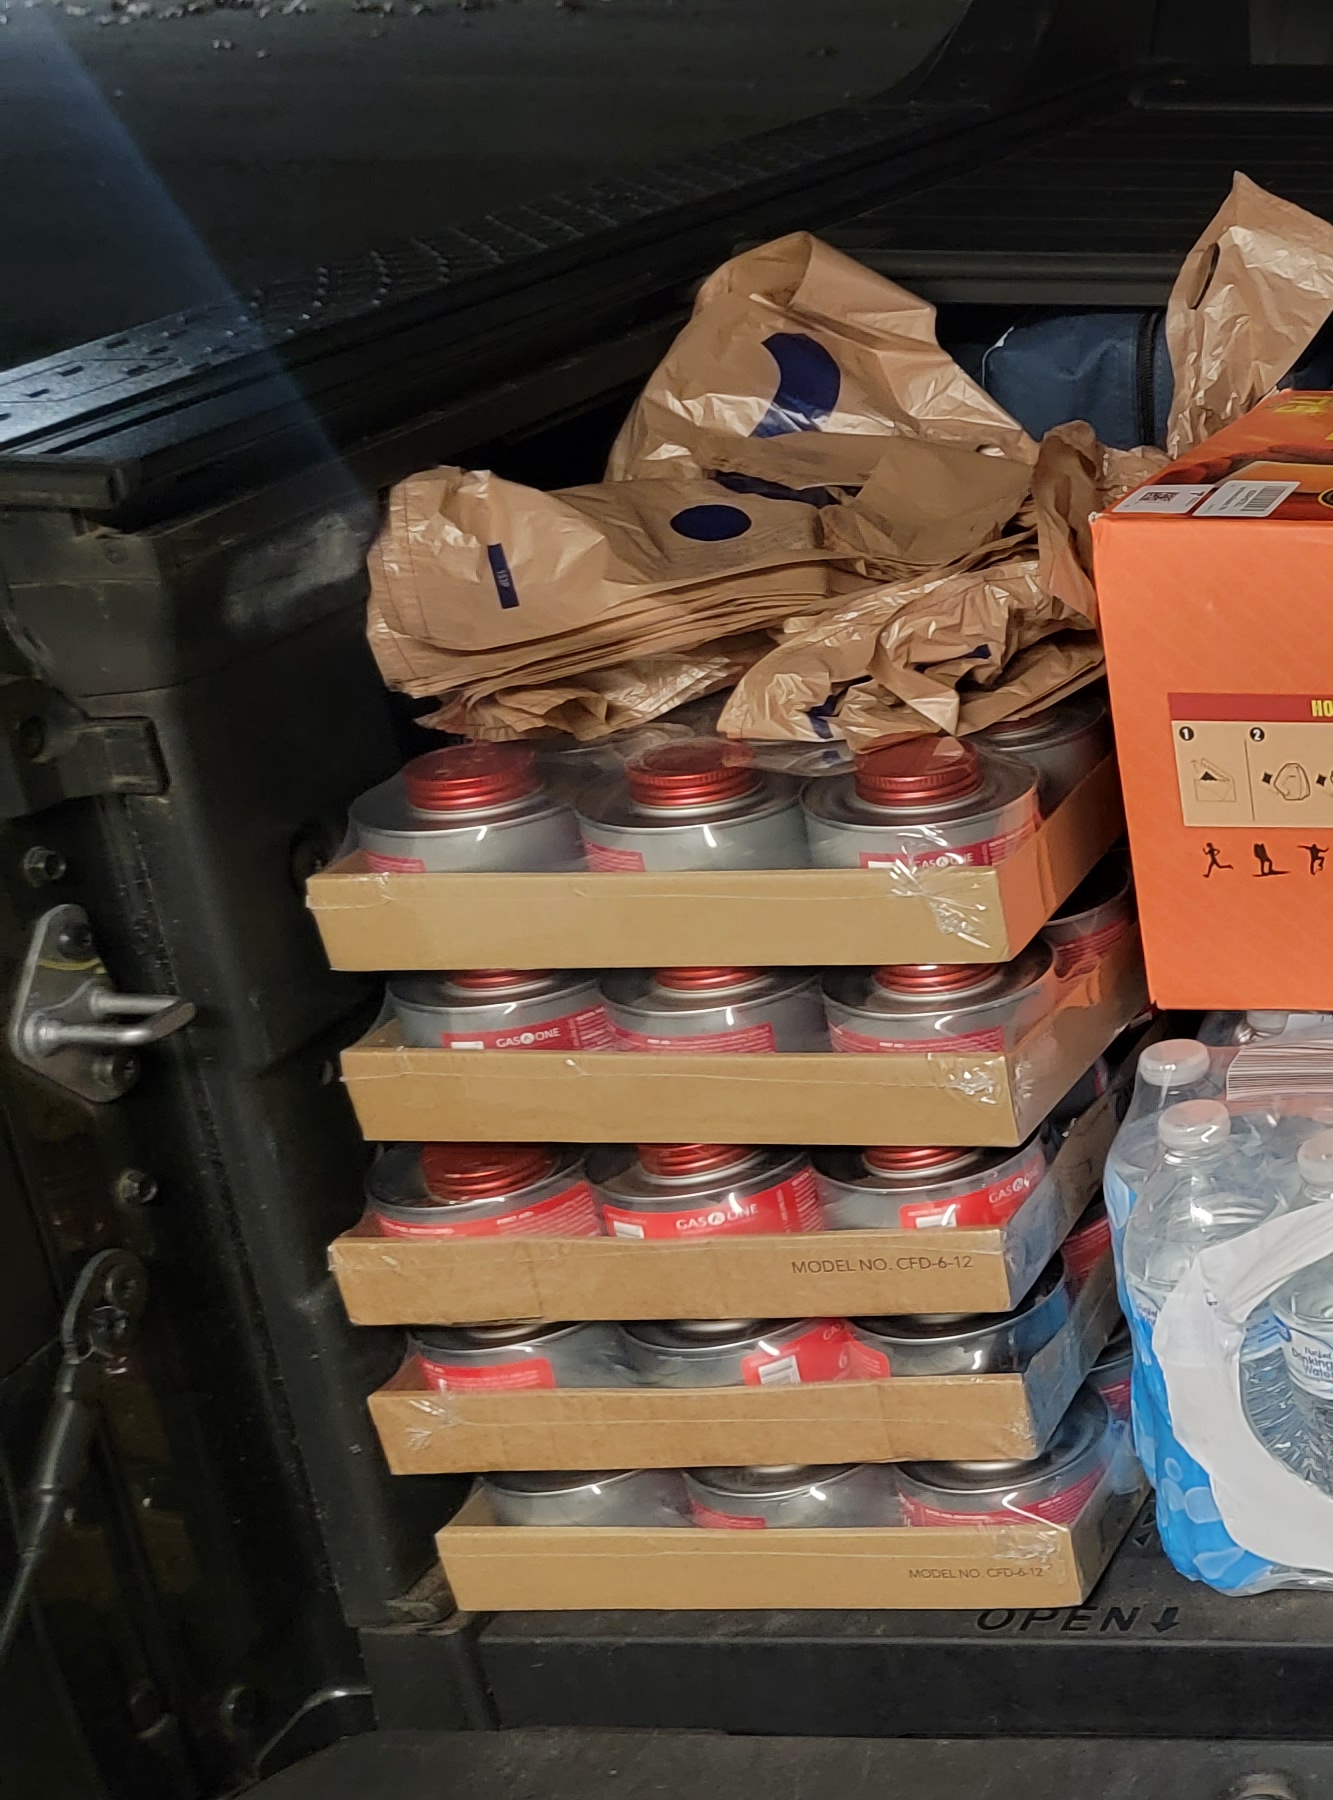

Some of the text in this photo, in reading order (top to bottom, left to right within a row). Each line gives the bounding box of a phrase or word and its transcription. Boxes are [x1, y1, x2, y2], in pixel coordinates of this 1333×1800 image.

[496, 1027, 561, 1048] GAS ONE
[988, 1184, 1014, 1204] GAS
[675, 1215, 708, 1230] GAS
[791, 1255, 974, 1274] MODEL NO. CFD-6-12
[909, 1568, 957, 1578] MODEL
[986, 1567, 1043, 1578] CFD-6-12
[977, 1605, 1141, 1631] OPEN
